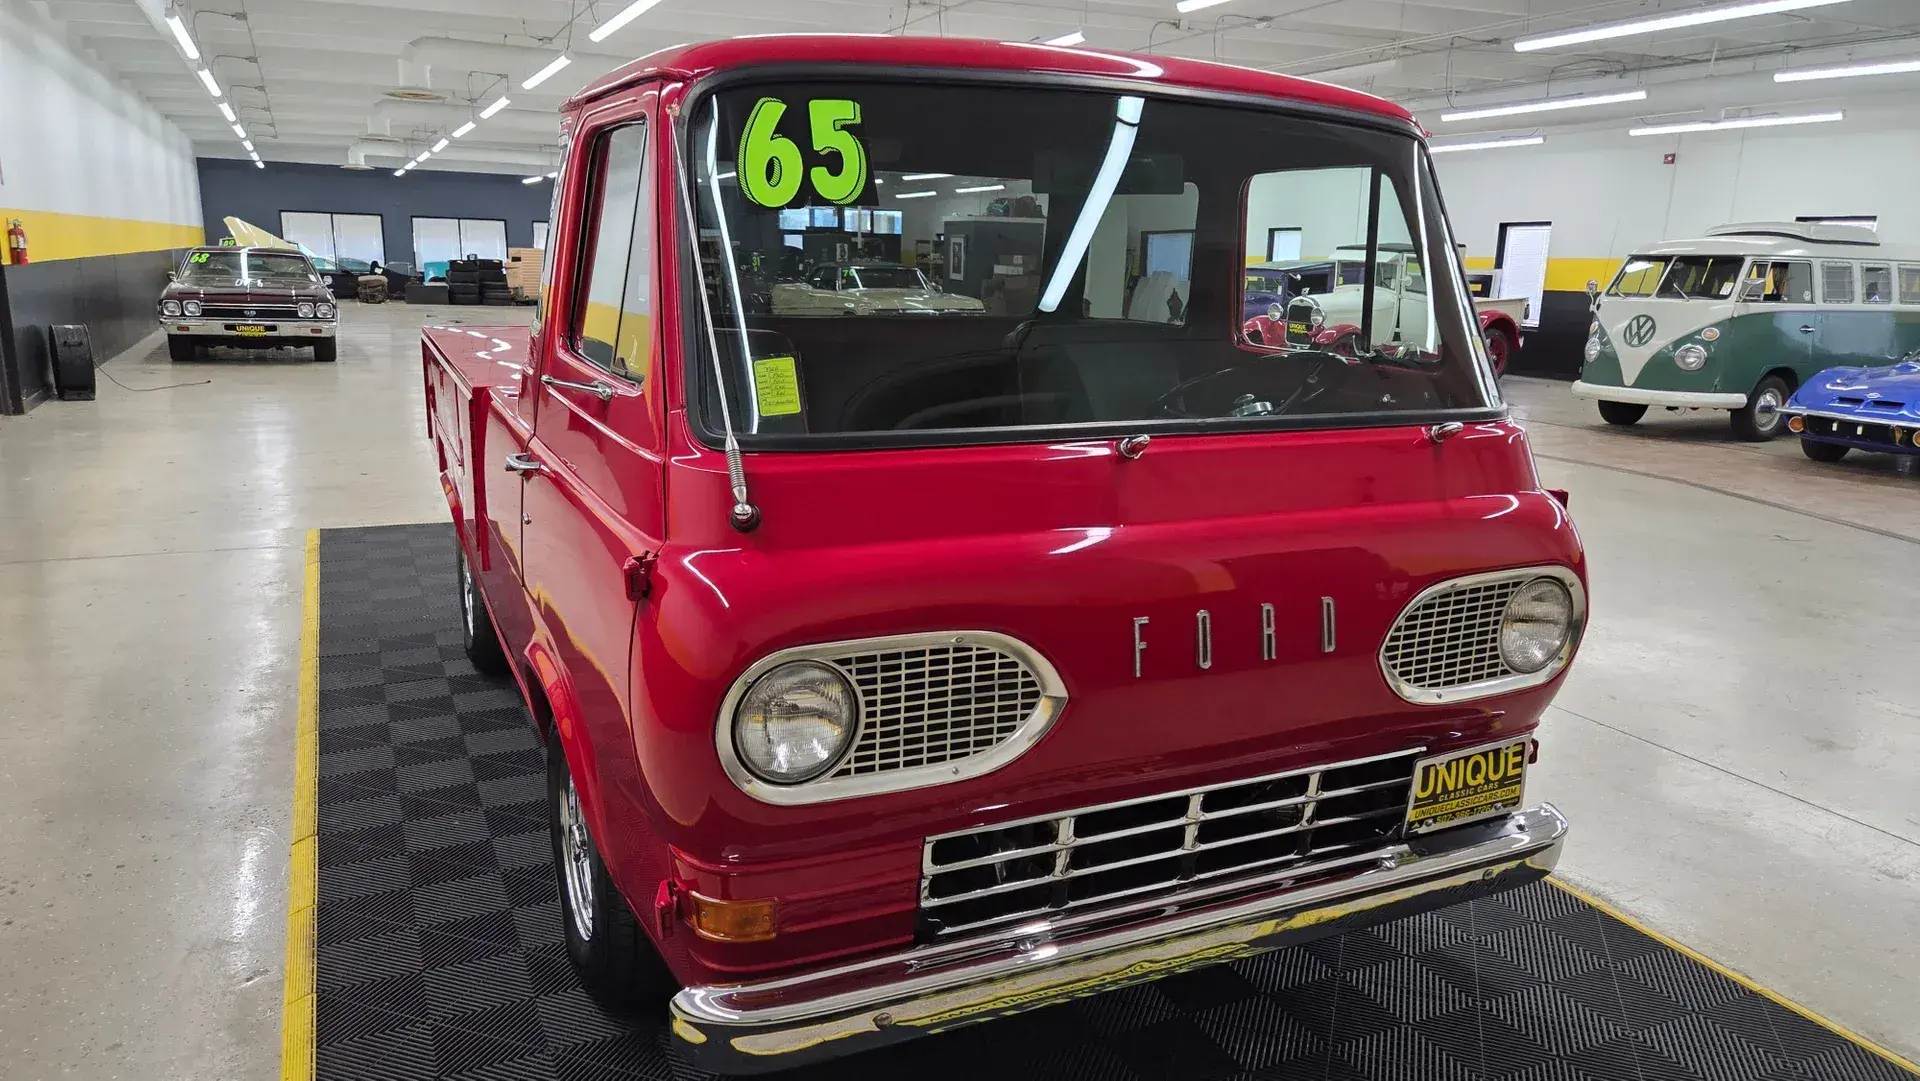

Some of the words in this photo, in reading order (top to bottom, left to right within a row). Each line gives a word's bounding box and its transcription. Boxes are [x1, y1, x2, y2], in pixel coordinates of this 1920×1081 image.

[738, 97, 867, 208] 65
[189, 252, 210, 264] 68
[1133, 596, 1336, 678] FORD
[1415, 745, 1523, 799] UNIQUE
[1438, 787, 1475, 802] CLASSIC
[1477, 781, 1499, 793] CARS
[1414, 786, 1518, 819] UNIQUECLASSICCARS.COM
